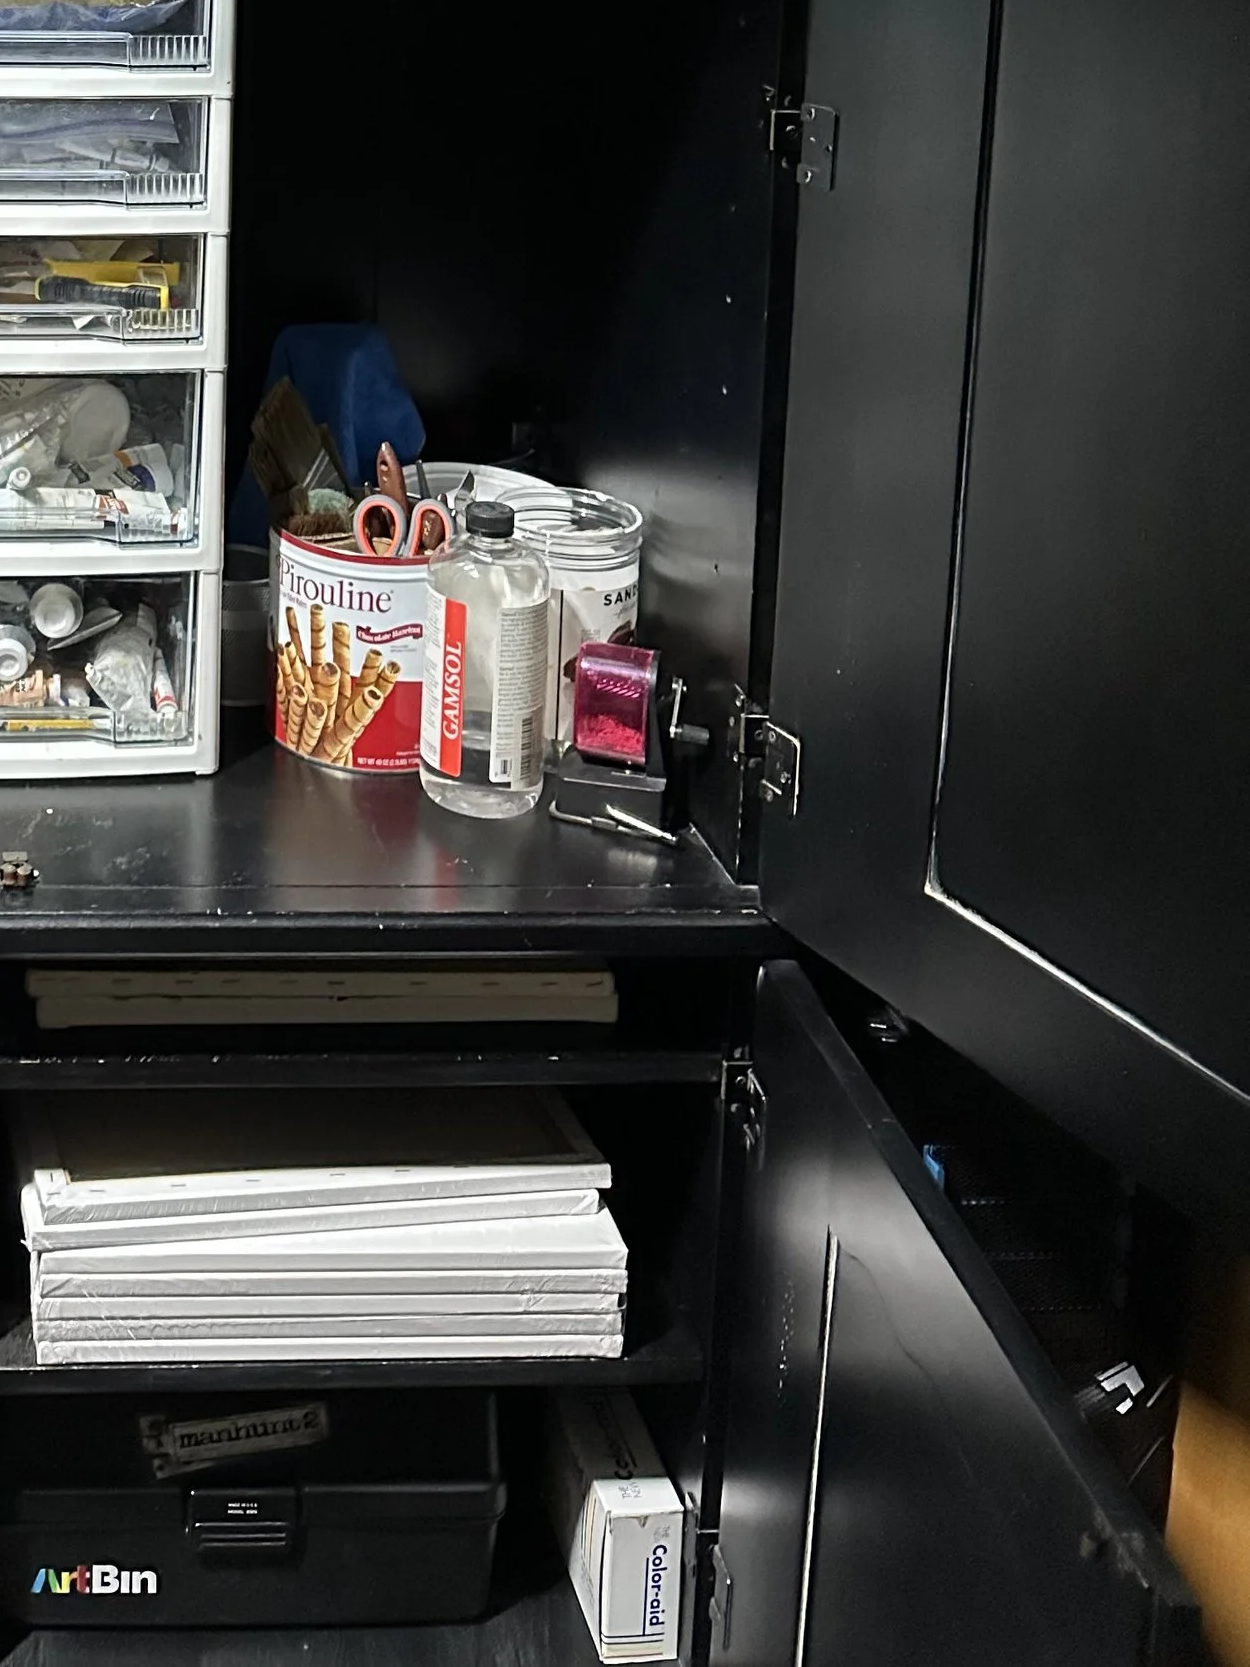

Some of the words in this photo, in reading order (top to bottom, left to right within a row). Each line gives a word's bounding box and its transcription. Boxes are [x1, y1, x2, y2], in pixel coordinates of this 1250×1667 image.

[279, 556, 392, 614] Pirouline
[443, 641, 462, 740] GAMSOL
[178, 1417, 301, 1449] manhunt
[302, 1410, 319, 1430] 2
[30, 1564, 157, 1594] ArtBin
[649, 1544, 668, 1627] Color-aid
